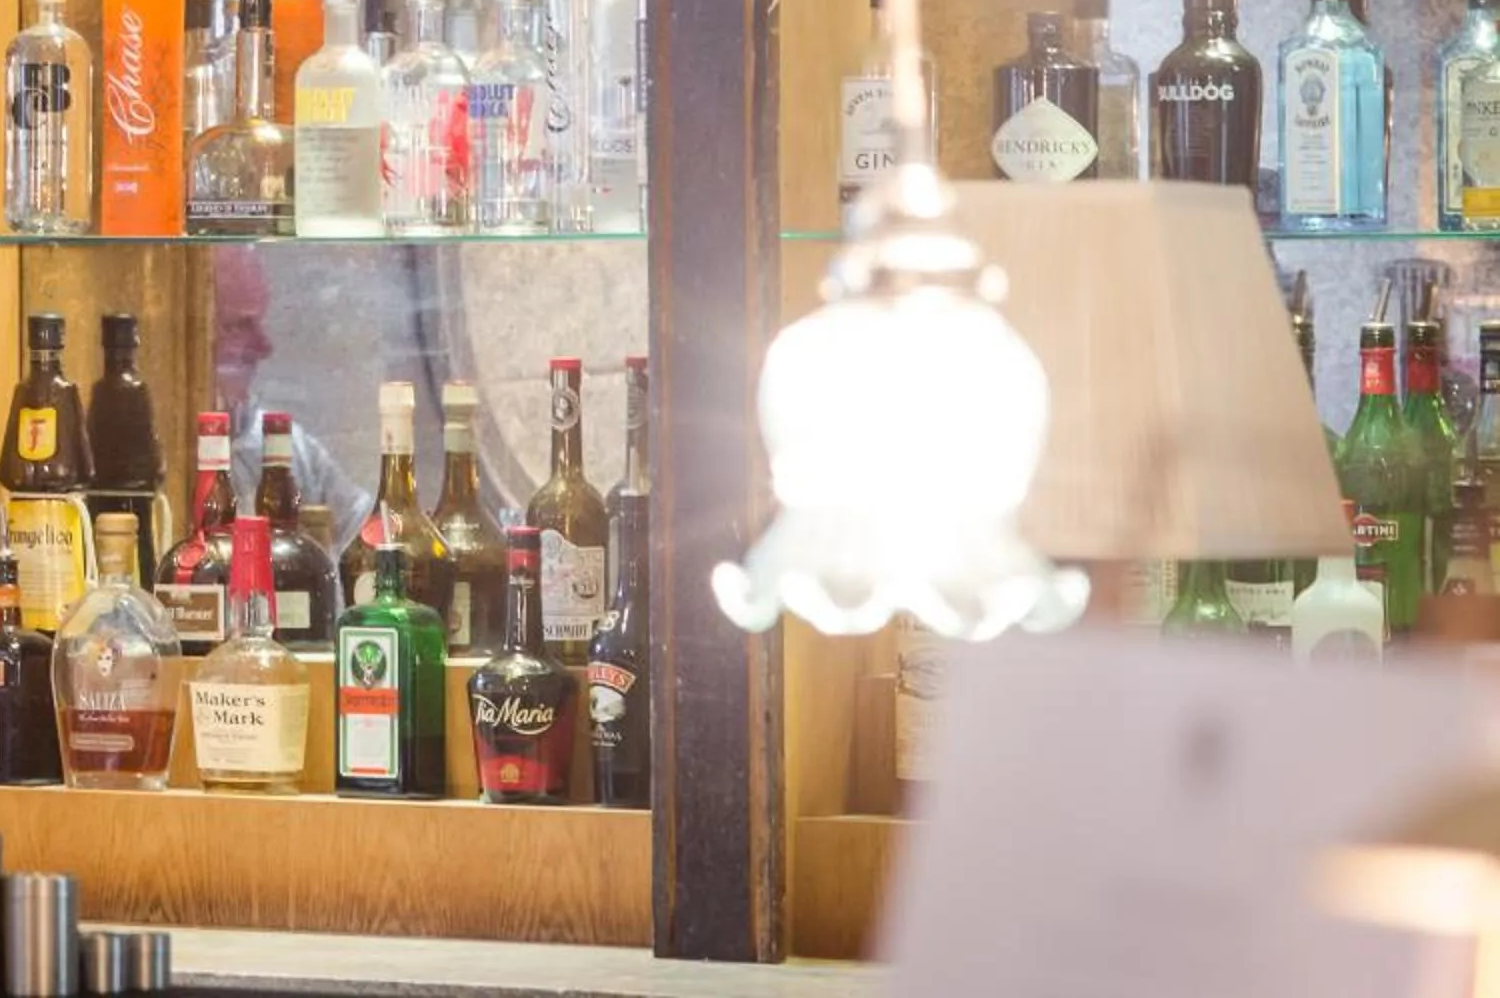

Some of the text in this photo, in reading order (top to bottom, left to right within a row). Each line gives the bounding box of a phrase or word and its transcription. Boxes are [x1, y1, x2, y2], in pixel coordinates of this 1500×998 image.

[105, 5, 156, 145] Chase
[856, 153, 896, 170] GIN
[196, 690, 266, 707] Maker's
[213, 710, 265, 726] Mark
[473, 694, 556, 725] Tia Maria
